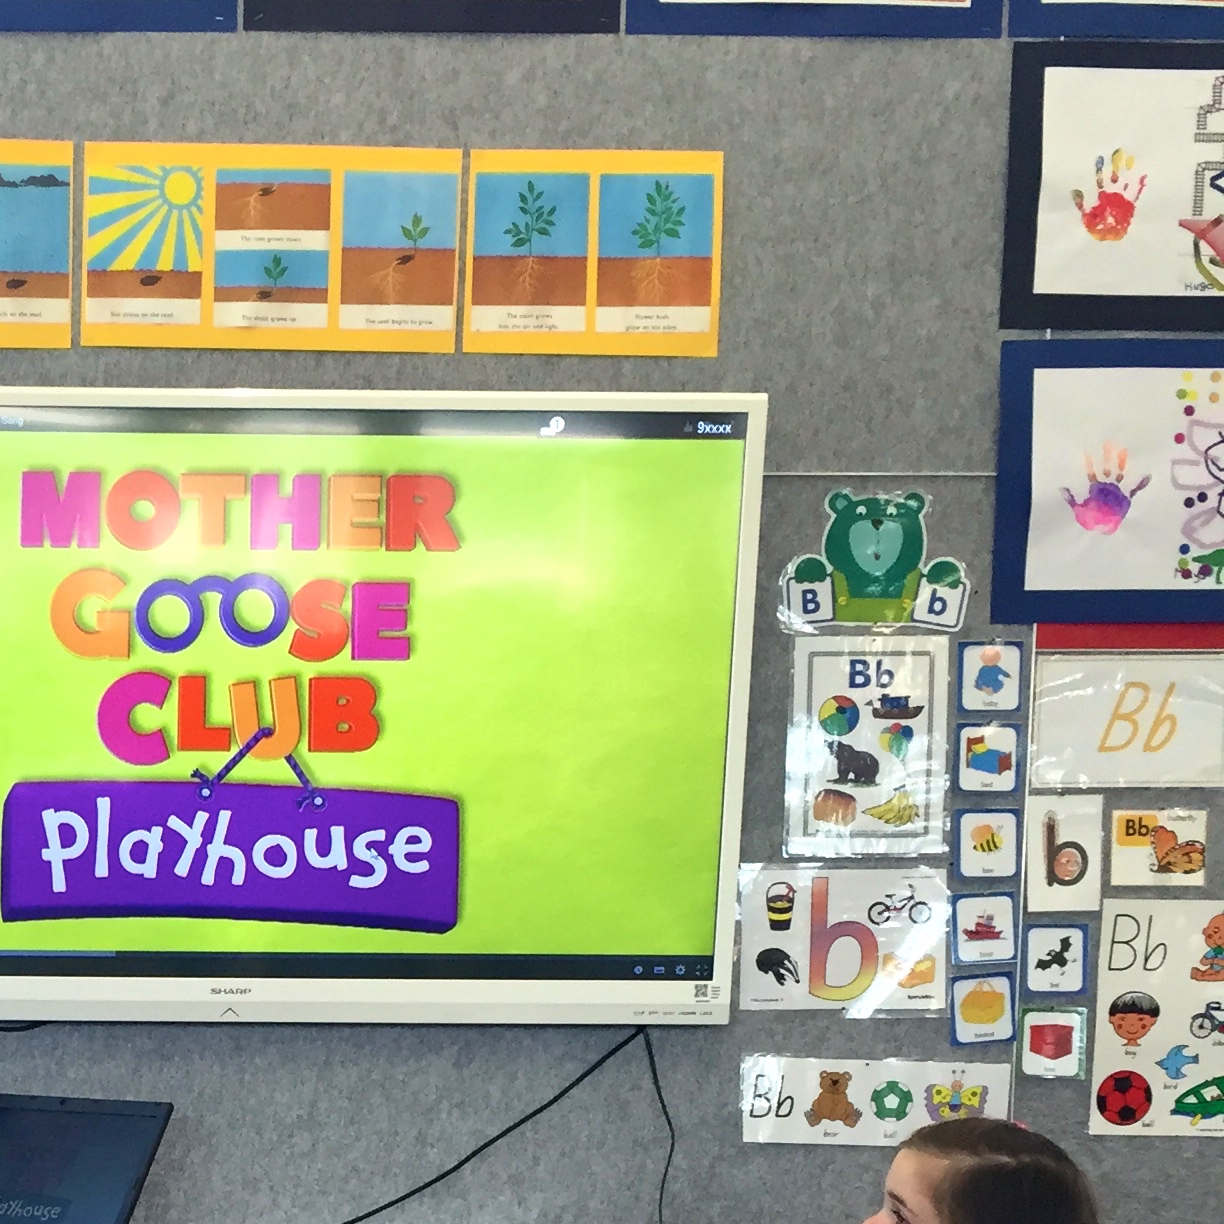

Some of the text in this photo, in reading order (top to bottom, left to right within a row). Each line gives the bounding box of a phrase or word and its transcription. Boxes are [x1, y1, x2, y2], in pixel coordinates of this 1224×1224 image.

[20, 470, 462, 552] MOTHER
[50, 567, 411, 662] GOOSE
[801, 588, 822, 615] B
[926, 586, 948, 616] b
[848, 659, 895, 690] Bb
[97, 671, 380, 766] CLUB
[1098, 680, 1178, 753] Bb
[41, 796, 433, 893] playhouse
[1042, 811, 1089, 887] b
[1125, 817, 1150, 837] Bb
[809, 876, 879, 1001] b
[1108, 913, 1167, 971] Bb
[209, 987, 252, 995] SHARP
[749, 1073, 795, 1118] Bb
